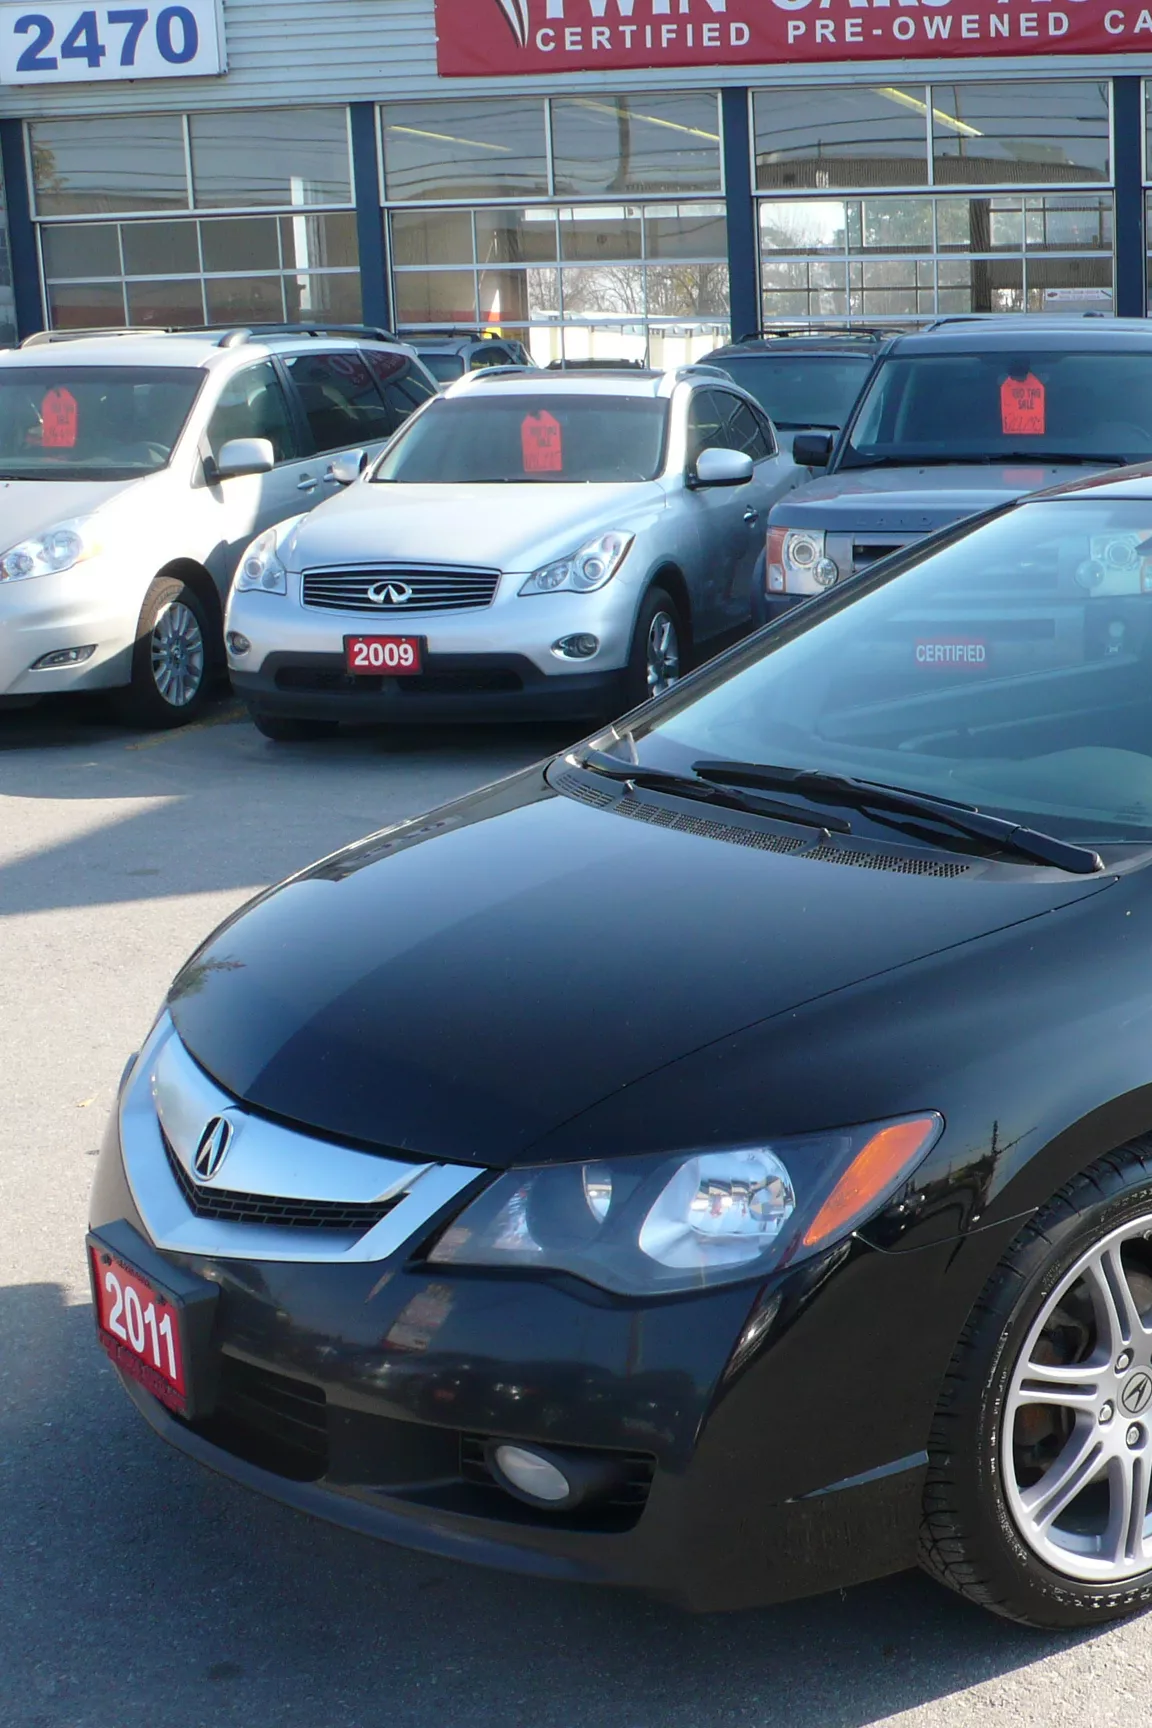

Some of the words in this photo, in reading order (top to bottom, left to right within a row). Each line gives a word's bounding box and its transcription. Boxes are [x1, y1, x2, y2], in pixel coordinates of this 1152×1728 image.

[13, 5, 199, 72] 2470
[536, 22, 750, 52] CERTIFIED
[787, 11, 1070, 44] PRE-OWENED
[353, 643, 414, 666] 2009
[916, 644, 986, 662] CERTIFIED
[105, 1271, 177, 1380] 2011
